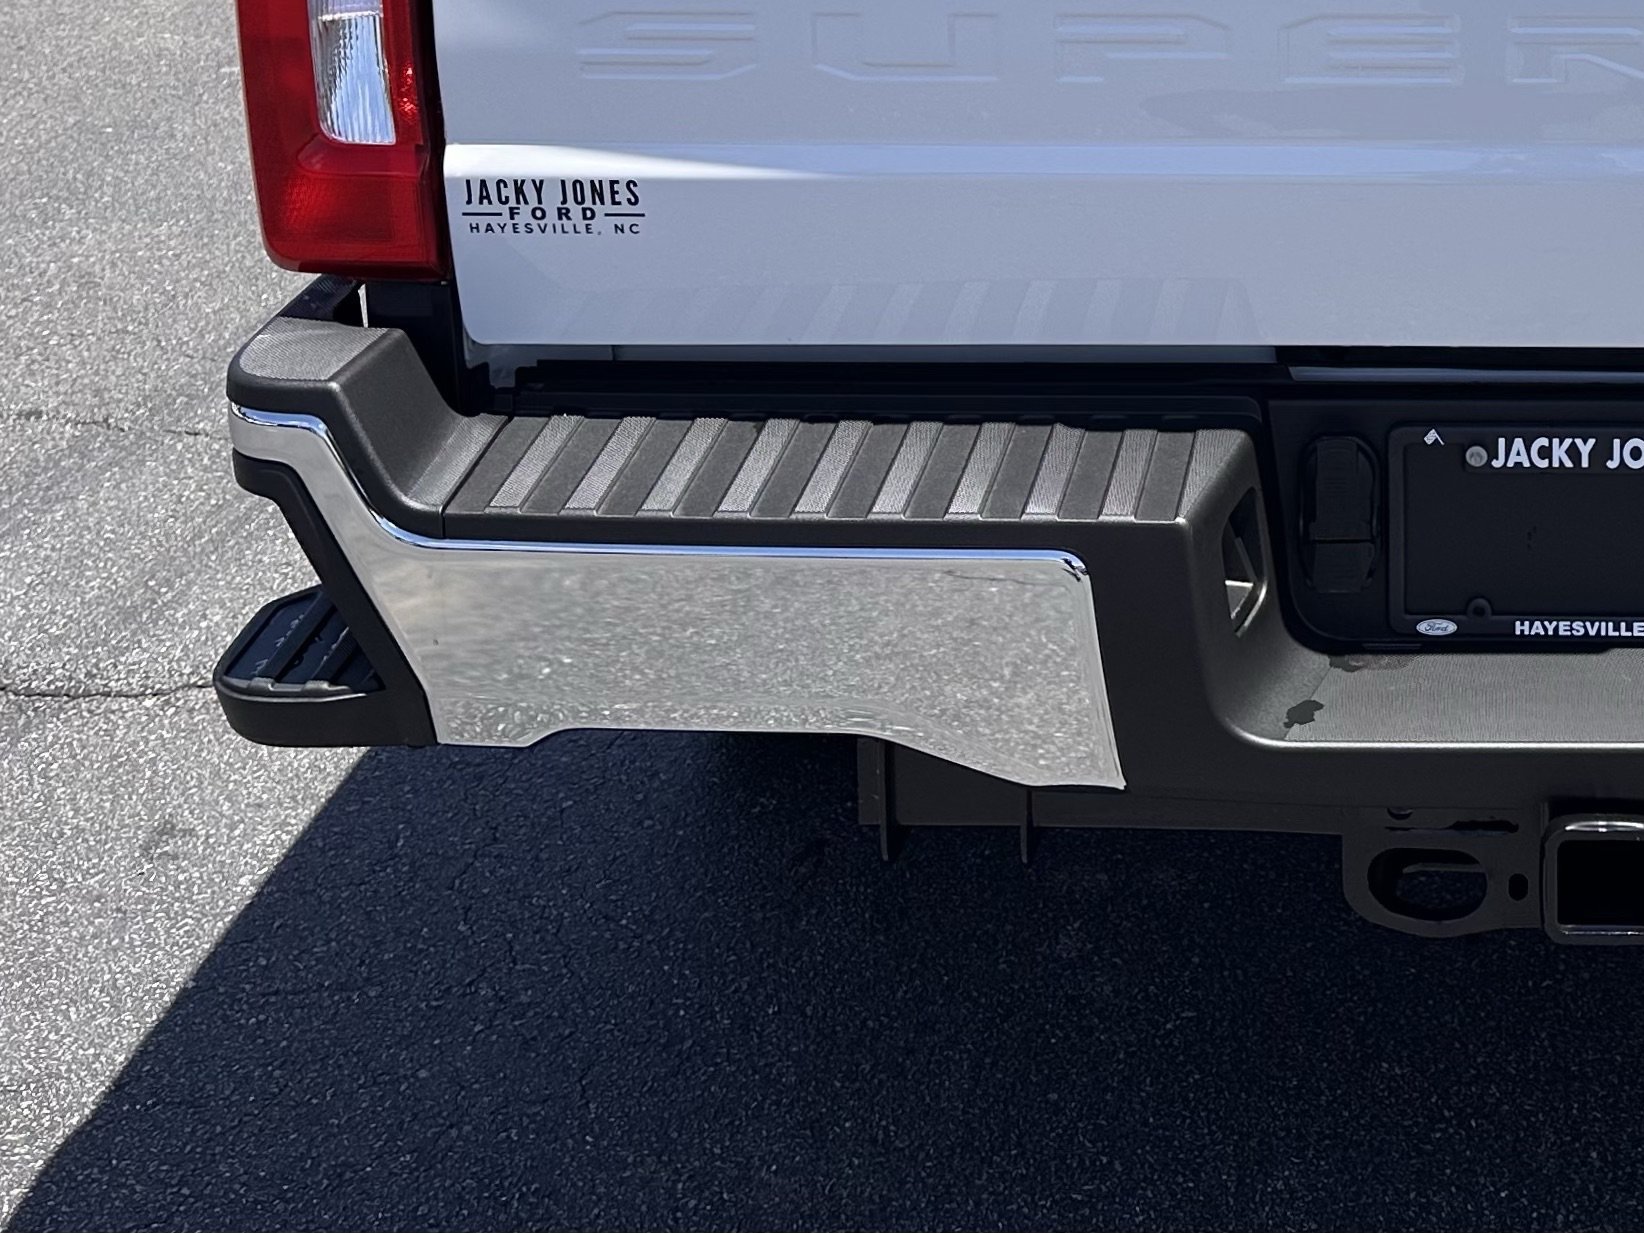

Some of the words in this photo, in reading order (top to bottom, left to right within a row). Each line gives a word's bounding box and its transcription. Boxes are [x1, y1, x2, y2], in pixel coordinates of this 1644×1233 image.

[465, 178, 545, 206] JACKY
[560, 179, 640, 206] JONES
[508, 206, 597, 221] FORD
[469, 222, 602, 236] HAYESVILLE,
[614, 223, 641, 235] NC
[1491, 437, 1597, 469] JACKY
